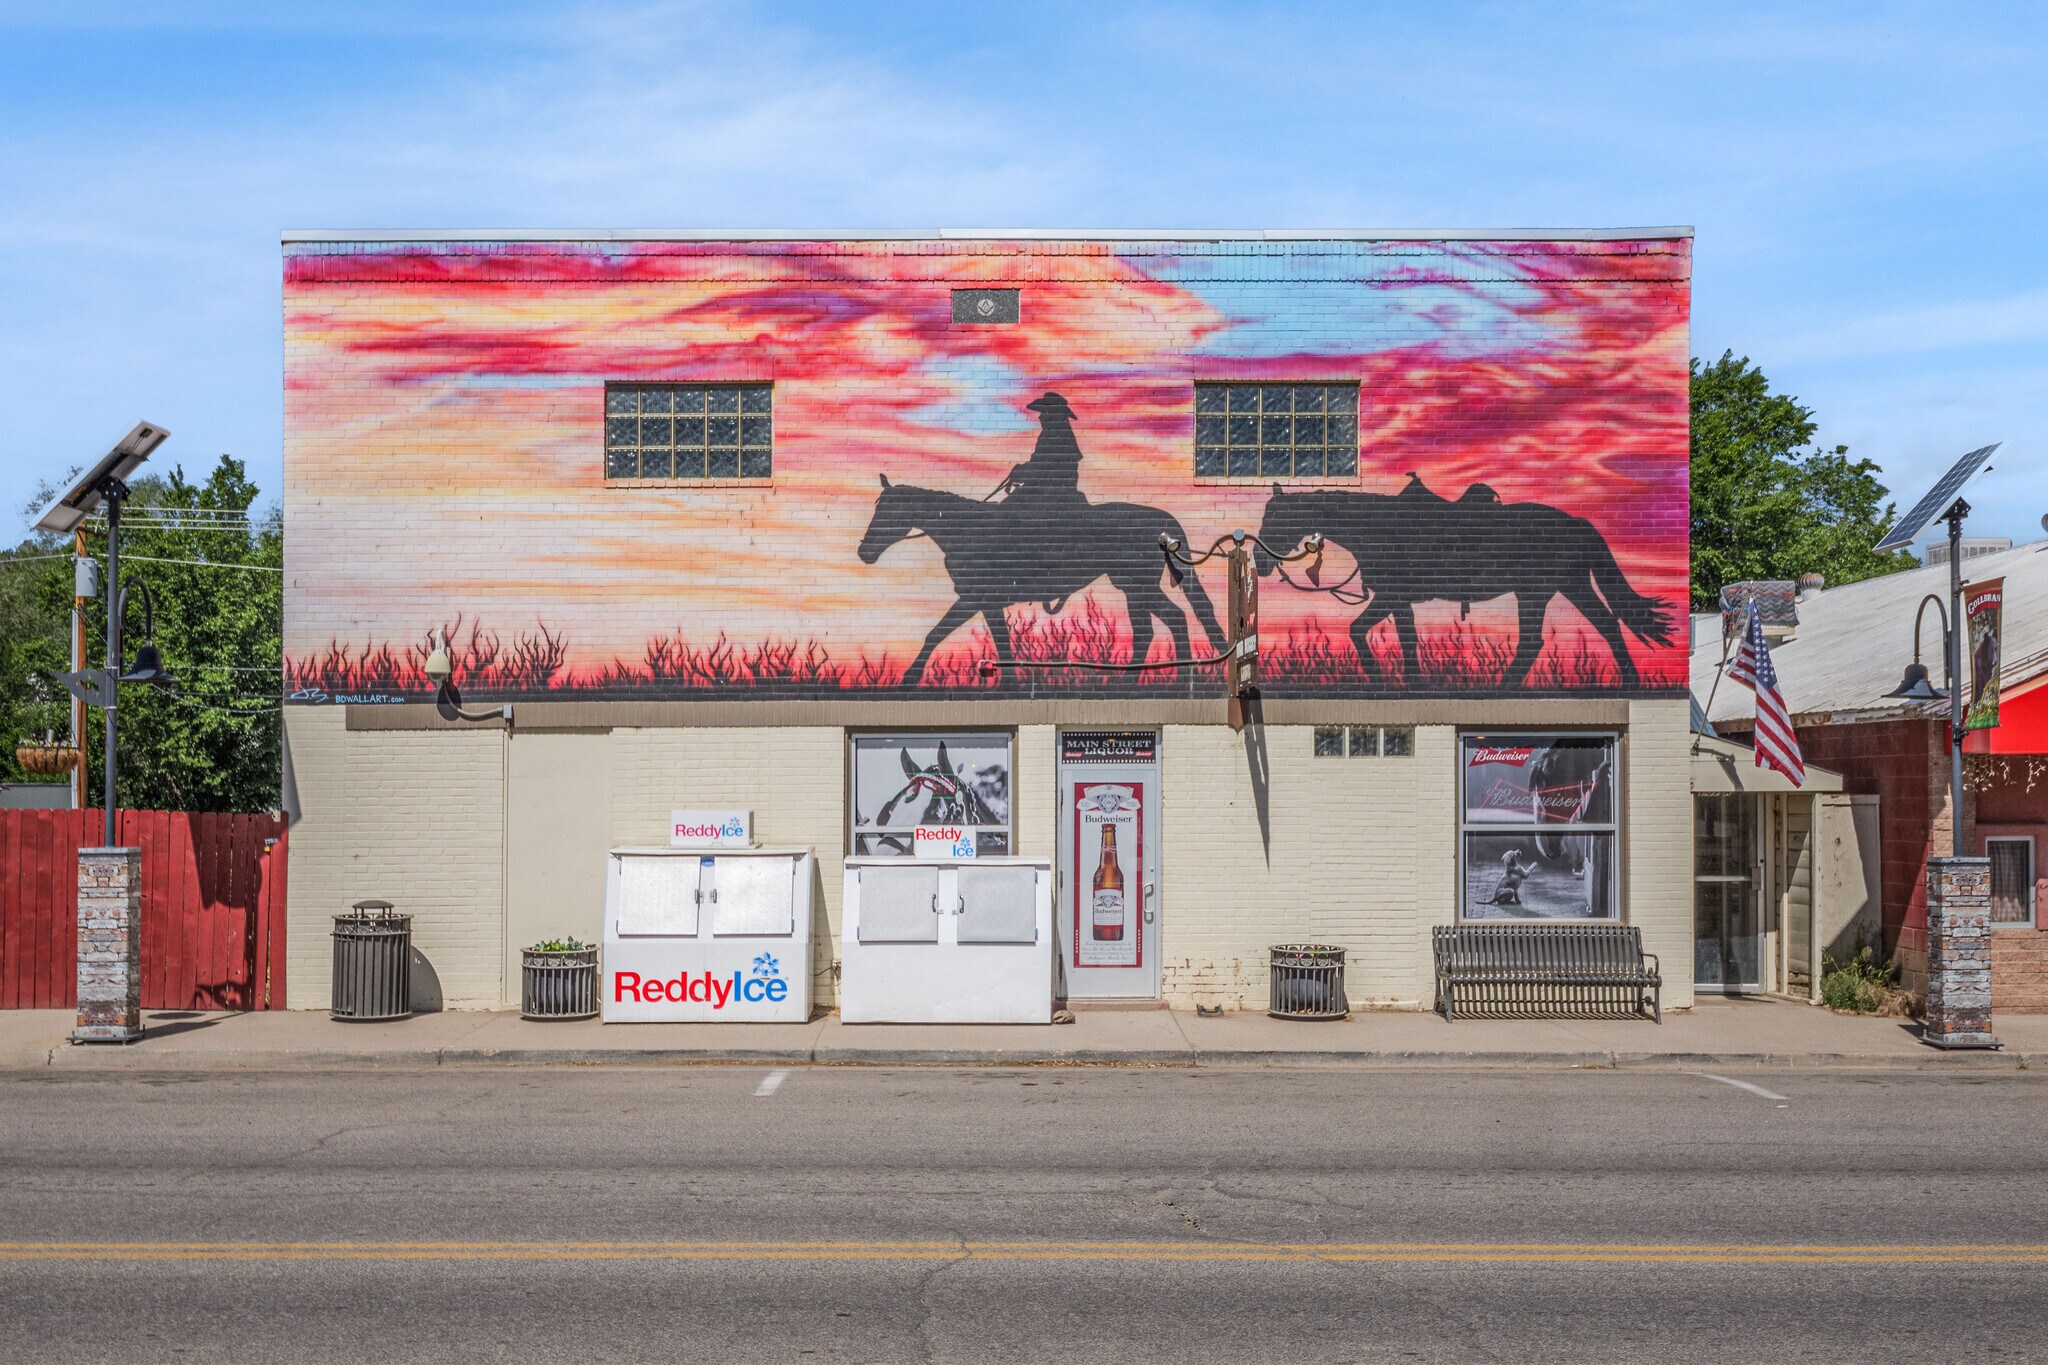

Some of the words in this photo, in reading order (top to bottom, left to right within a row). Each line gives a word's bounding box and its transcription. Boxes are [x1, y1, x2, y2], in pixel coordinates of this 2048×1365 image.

[1968, 593, 2001, 614] COLLBRAN
[1085, 747, 1134, 756] LIQUOR
[1473, 748, 1530, 761] Budweiser
[1085, 815, 1132, 823] Budweiser
[915, 827, 962, 842] Reddy
[953, 844, 974, 857] Ice
